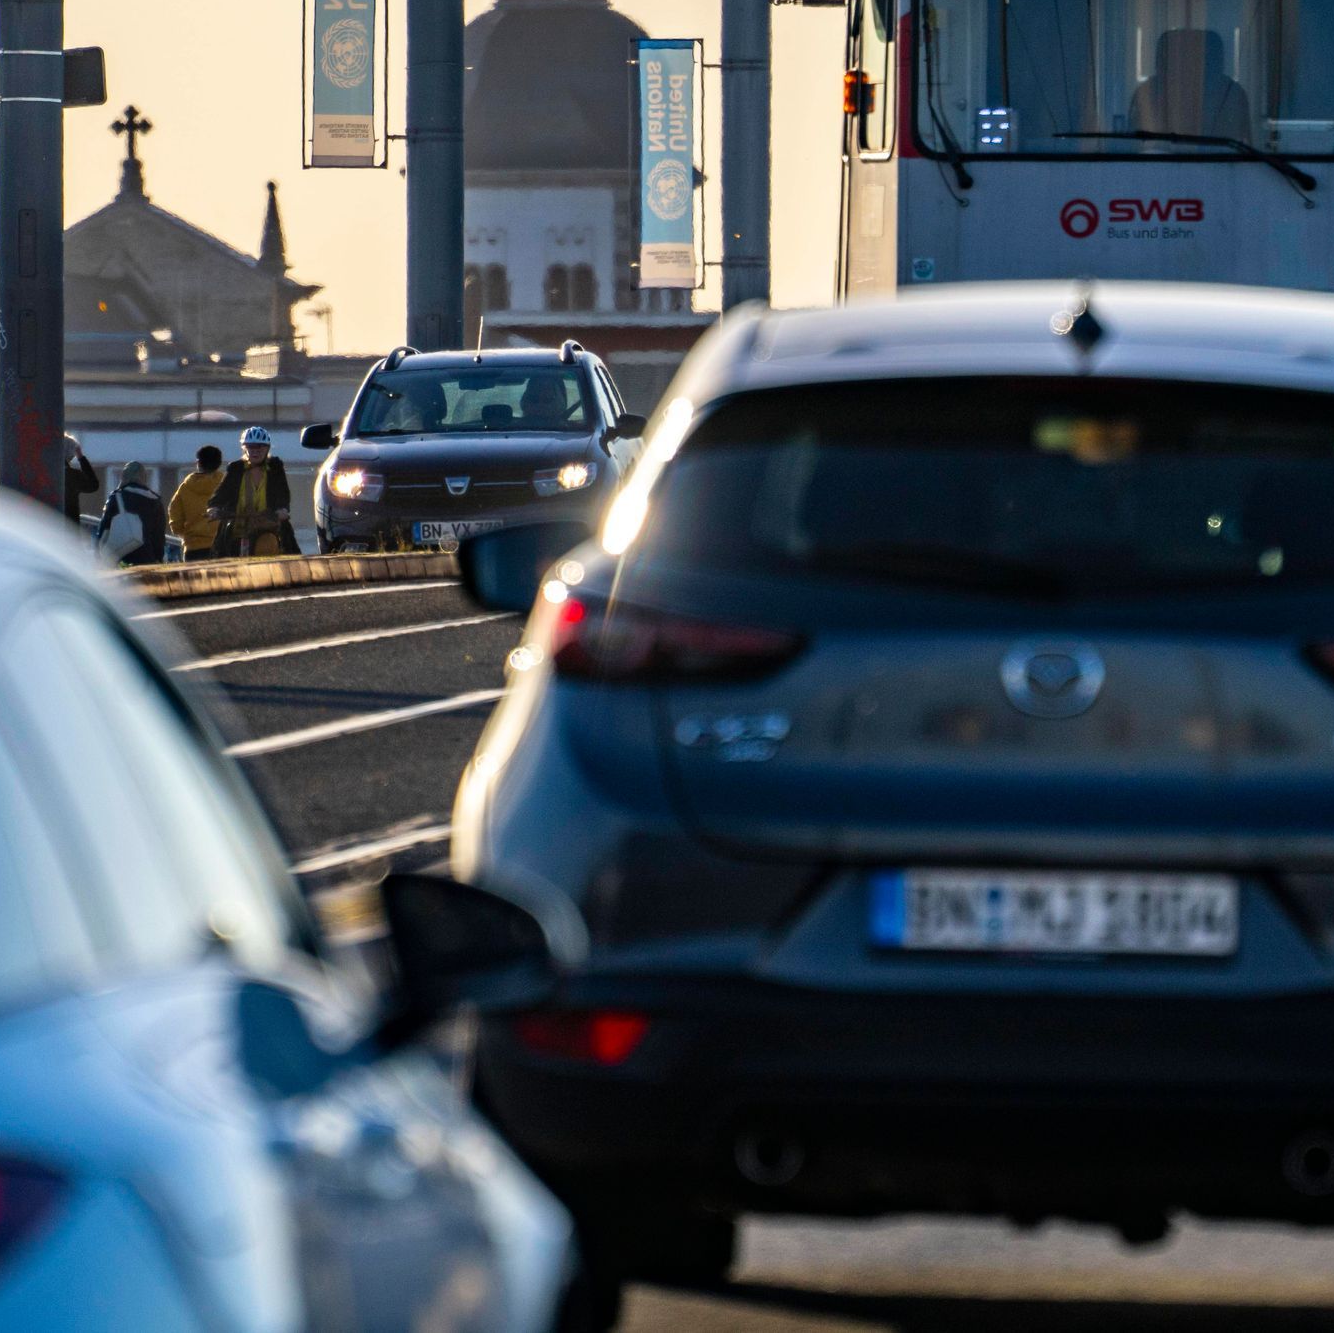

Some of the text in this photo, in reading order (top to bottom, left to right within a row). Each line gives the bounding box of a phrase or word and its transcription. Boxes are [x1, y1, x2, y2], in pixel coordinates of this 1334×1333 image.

[1108, 198, 1204, 222] SWB
[1108, 227, 1194, 239] Bus und Bahn
[421, 524, 442, 539] BN
[451, 523, 471, 539] VX
